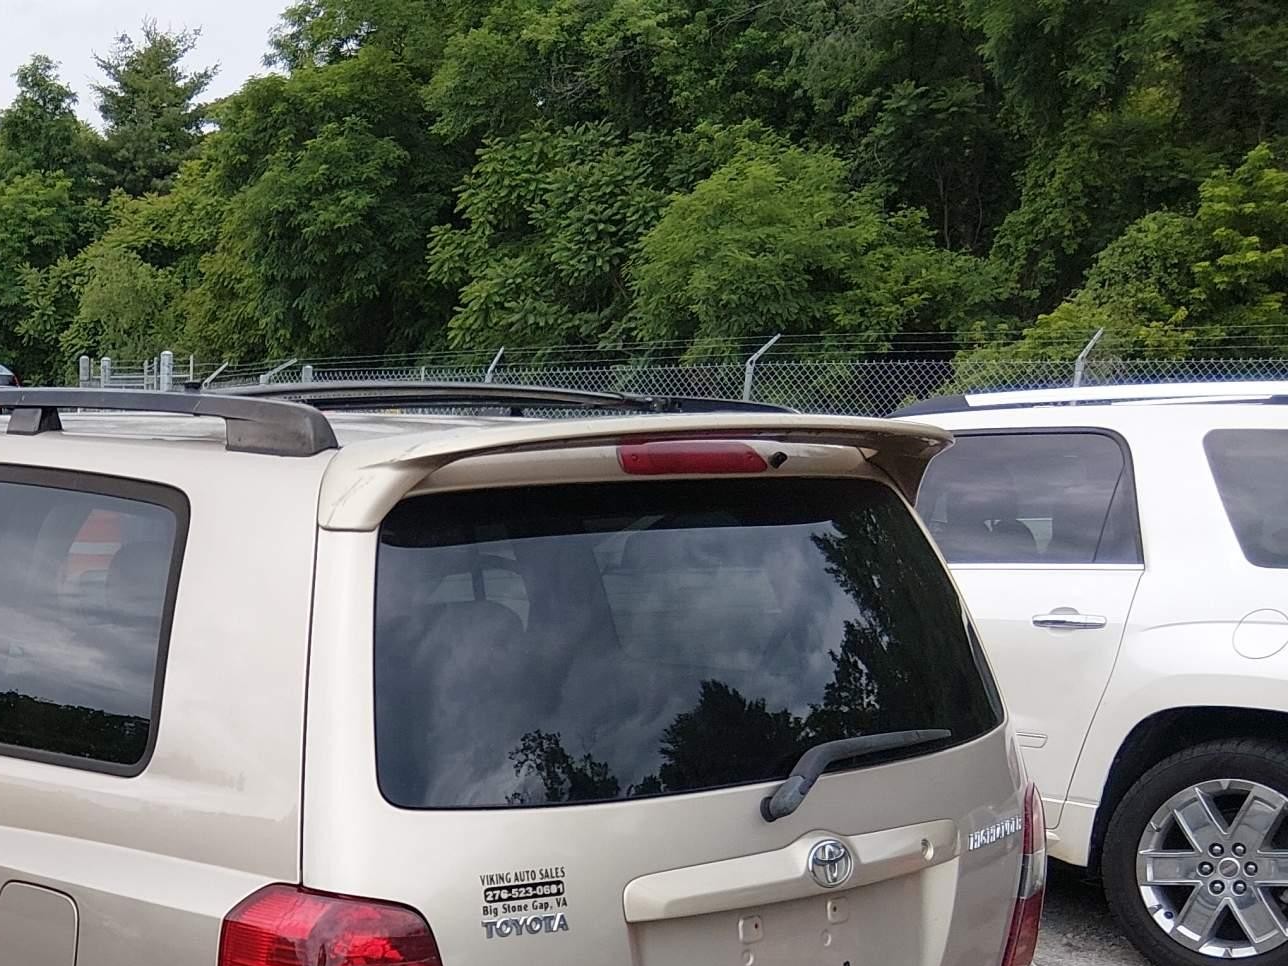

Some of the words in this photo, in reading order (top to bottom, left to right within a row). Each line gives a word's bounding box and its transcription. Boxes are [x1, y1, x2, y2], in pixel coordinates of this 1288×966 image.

[480, 872, 511, 886] VIKING
[514, 870, 536, 883] AUTO
[539, 867, 565, 880] SALES
[482, 905, 498, 917] Big
[502, 903, 528, 914] Stone
[555, 897, 568, 908] VA
[481, 913, 569, 939] TOYOTA
